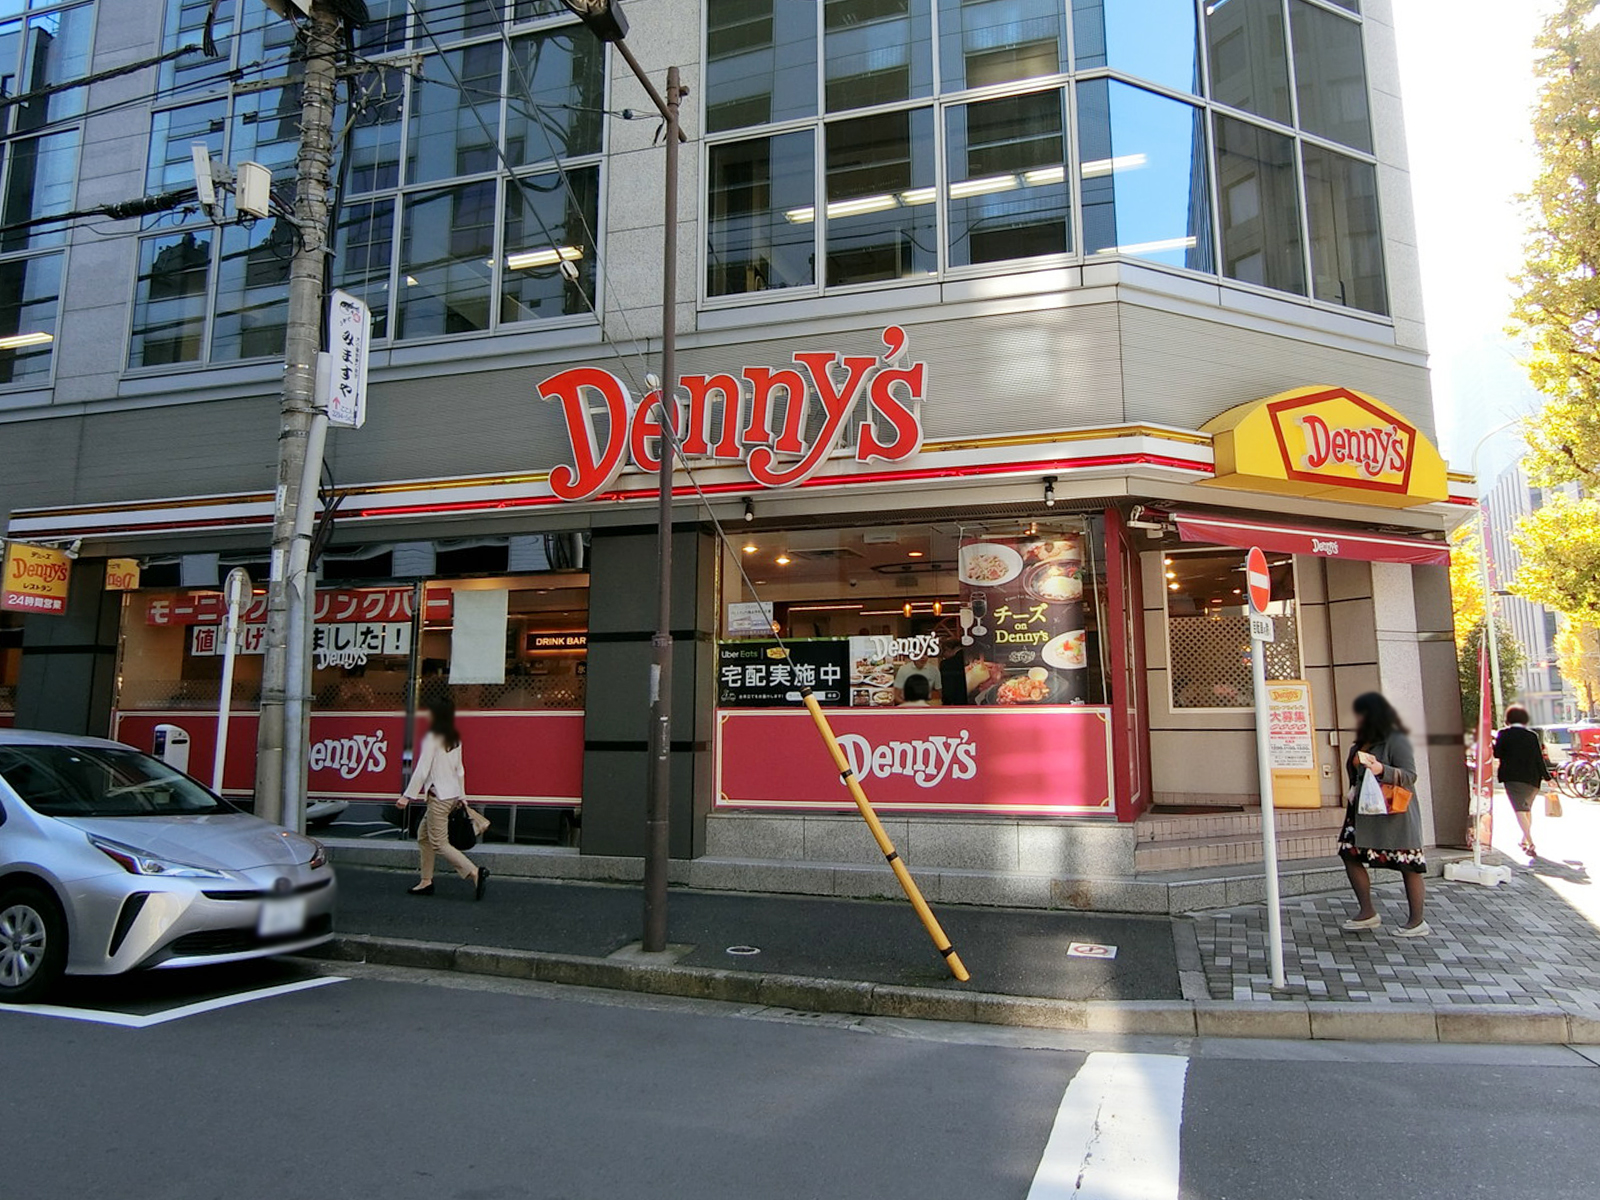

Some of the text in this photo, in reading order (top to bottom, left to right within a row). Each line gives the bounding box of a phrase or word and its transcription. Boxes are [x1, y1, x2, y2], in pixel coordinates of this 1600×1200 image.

[536, 324, 928, 502] Denny's
[1302, 415, 1406, 477] Denny's
[12, 558, 68, 583] Denny's
[23, 582, 53, 592] レストラン
[8, 594, 62, 610] 24時間営業
[993, 602, 1049, 625] チーズ
[995, 630, 1049, 646] Denny's
[1014, 622, 1028, 630] on
[535, 636, 587, 646] DRINK BAR
[870, 631, 940, 661] Denny's
[721, 650, 739, 659] Uber
[740, 650, 758, 658] Eats
[721, 662, 841, 688] 宅配実施中
[309, 730, 388, 779] enny's
[836, 729, 977, 788] Denny's
